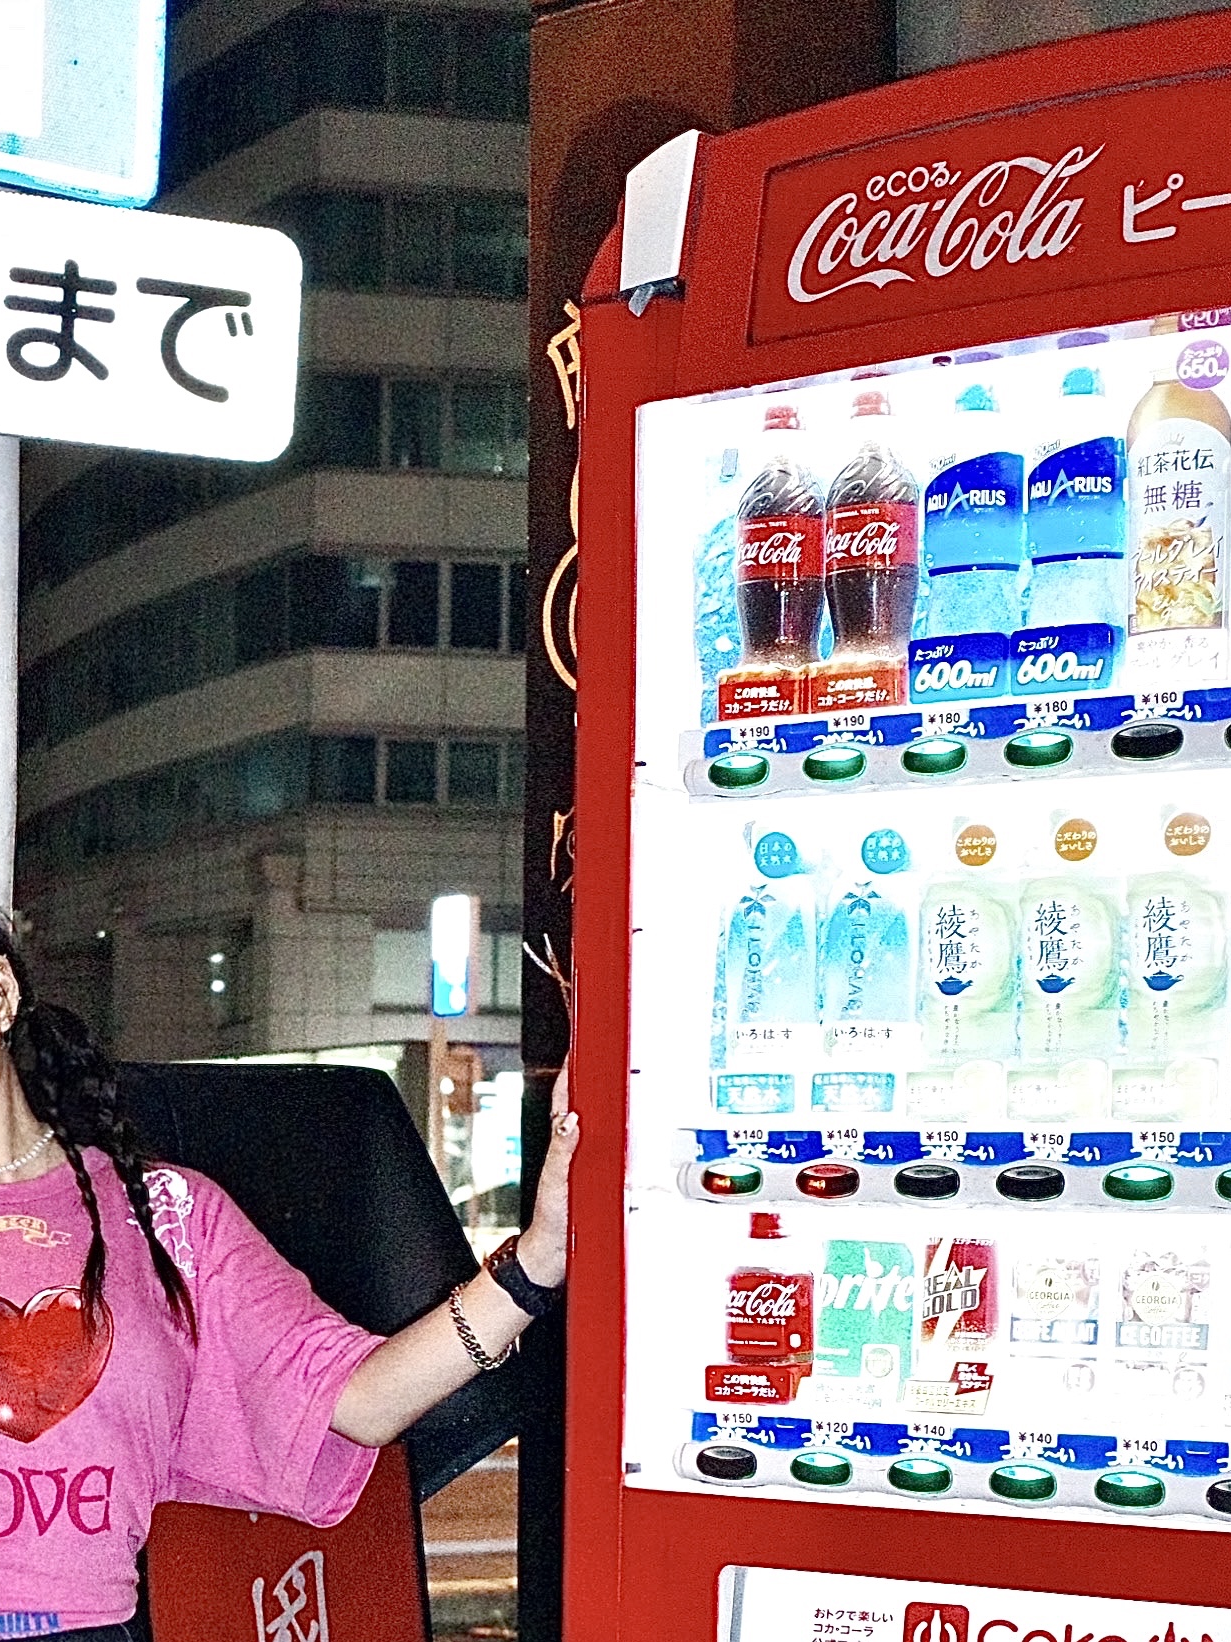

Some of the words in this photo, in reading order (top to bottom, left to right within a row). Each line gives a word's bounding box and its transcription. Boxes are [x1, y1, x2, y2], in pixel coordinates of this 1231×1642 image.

[788, 143, 1106, 303] Coca-Cola
[1137, 448, 1215, 477] 紅茶花伝
[1144, 479, 1204, 515] 無糖
[1017, 637, 1059, 653] たっぷり
[915, 644, 954, 661] たっぷり
[1017, 652, 1104, 685] 600ml
[915, 660, 997, 693] 600ml
[1141, 691, 1177, 705] ¥160
[1034, 701, 1068, 714] ¥180
[833, 715, 865, 728] ¥190
[928, 712, 960, 725] ¥180
[739, 726, 770, 738] ¥190
[1055, 830, 1097, 842] こだわりの
[1165, 824, 1210, 836] こだわりの
[956, 836, 997, 847] こだわりの
[1058, 840, 1093, 852] おいしさ
[1168, 835, 1206, 847] おいしさ
[959, 846, 992, 857] おいしさ
[935, 904, 967, 974] 綾鷹
[969, 908, 982, 969] あやたか
[1035, 900, 1068, 971] 綾鷹
[1070, 904, 1084, 966] あやたか
[1143, 896, 1179, 969] 綾鷹
[732, 1129, 763, 1140] ¥140
[826, 1128, 858, 1140] ¥140
[925, 1130, 958, 1142] ¥150
[1030, 1133, 1064, 1146] ¥150
[1139, 1131, 1175, 1144] ¥150
[1029, 1290, 1071, 1301] GEORGIA
[1136, 1294, 1177, 1306] GEORGIA
[722, 1413, 752, 1424] ¥150
[815, 1421, 848, 1433] ¥120
[912, 1423, 945, 1436] ¥140
[1018, 1431, 1052, 1444] ¥140
[1123, 1439, 1158, 1452] ¥140
[814, 1607, 894, 1624] おトクで楽しい
[812, 1623, 874, 1637] コカ・コーラ
